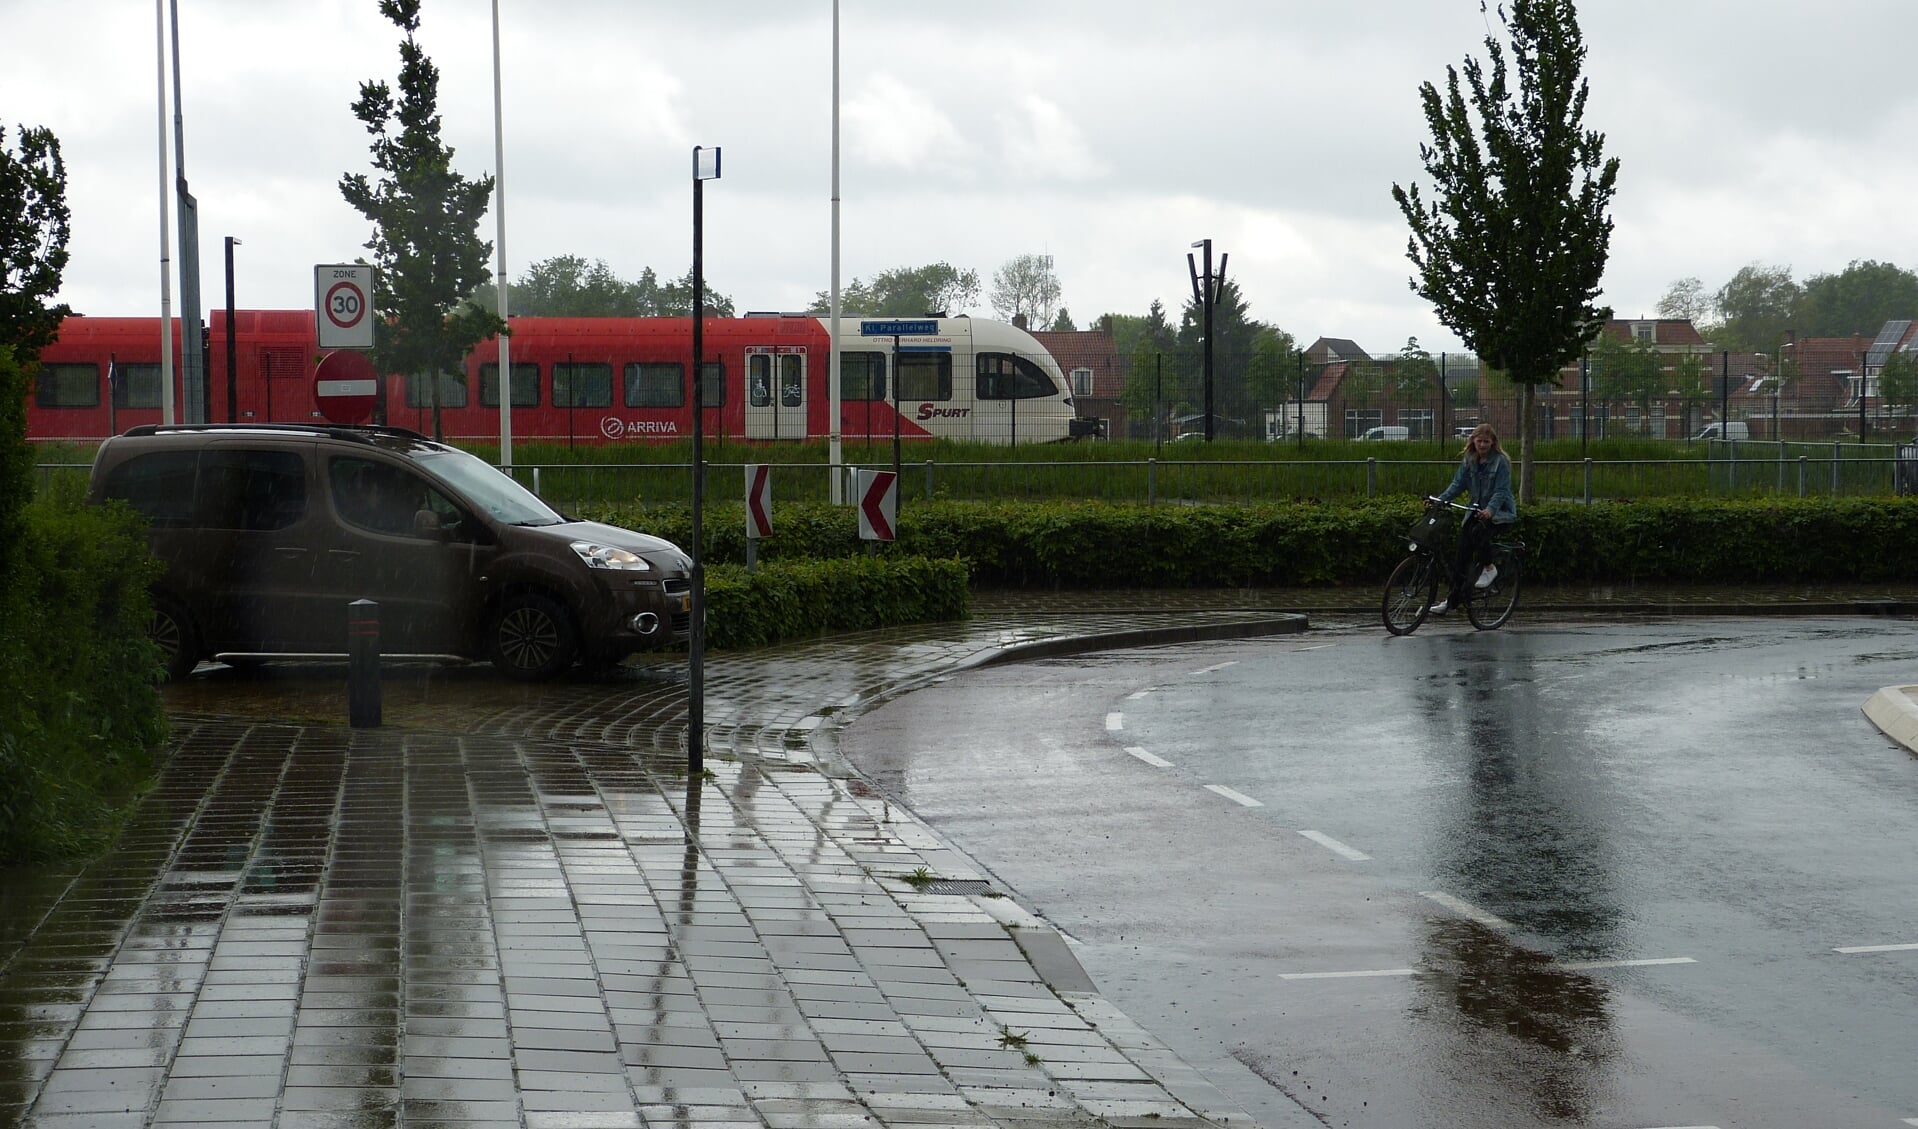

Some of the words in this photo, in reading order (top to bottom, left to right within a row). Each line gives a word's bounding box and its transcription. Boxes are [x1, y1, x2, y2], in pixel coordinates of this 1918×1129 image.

[333, 270, 356, 279] ZONE
[333, 296, 359, 314] 30
[880, 323, 935, 333] Parallelweg
[627, 422, 678, 433] ARRIVA
